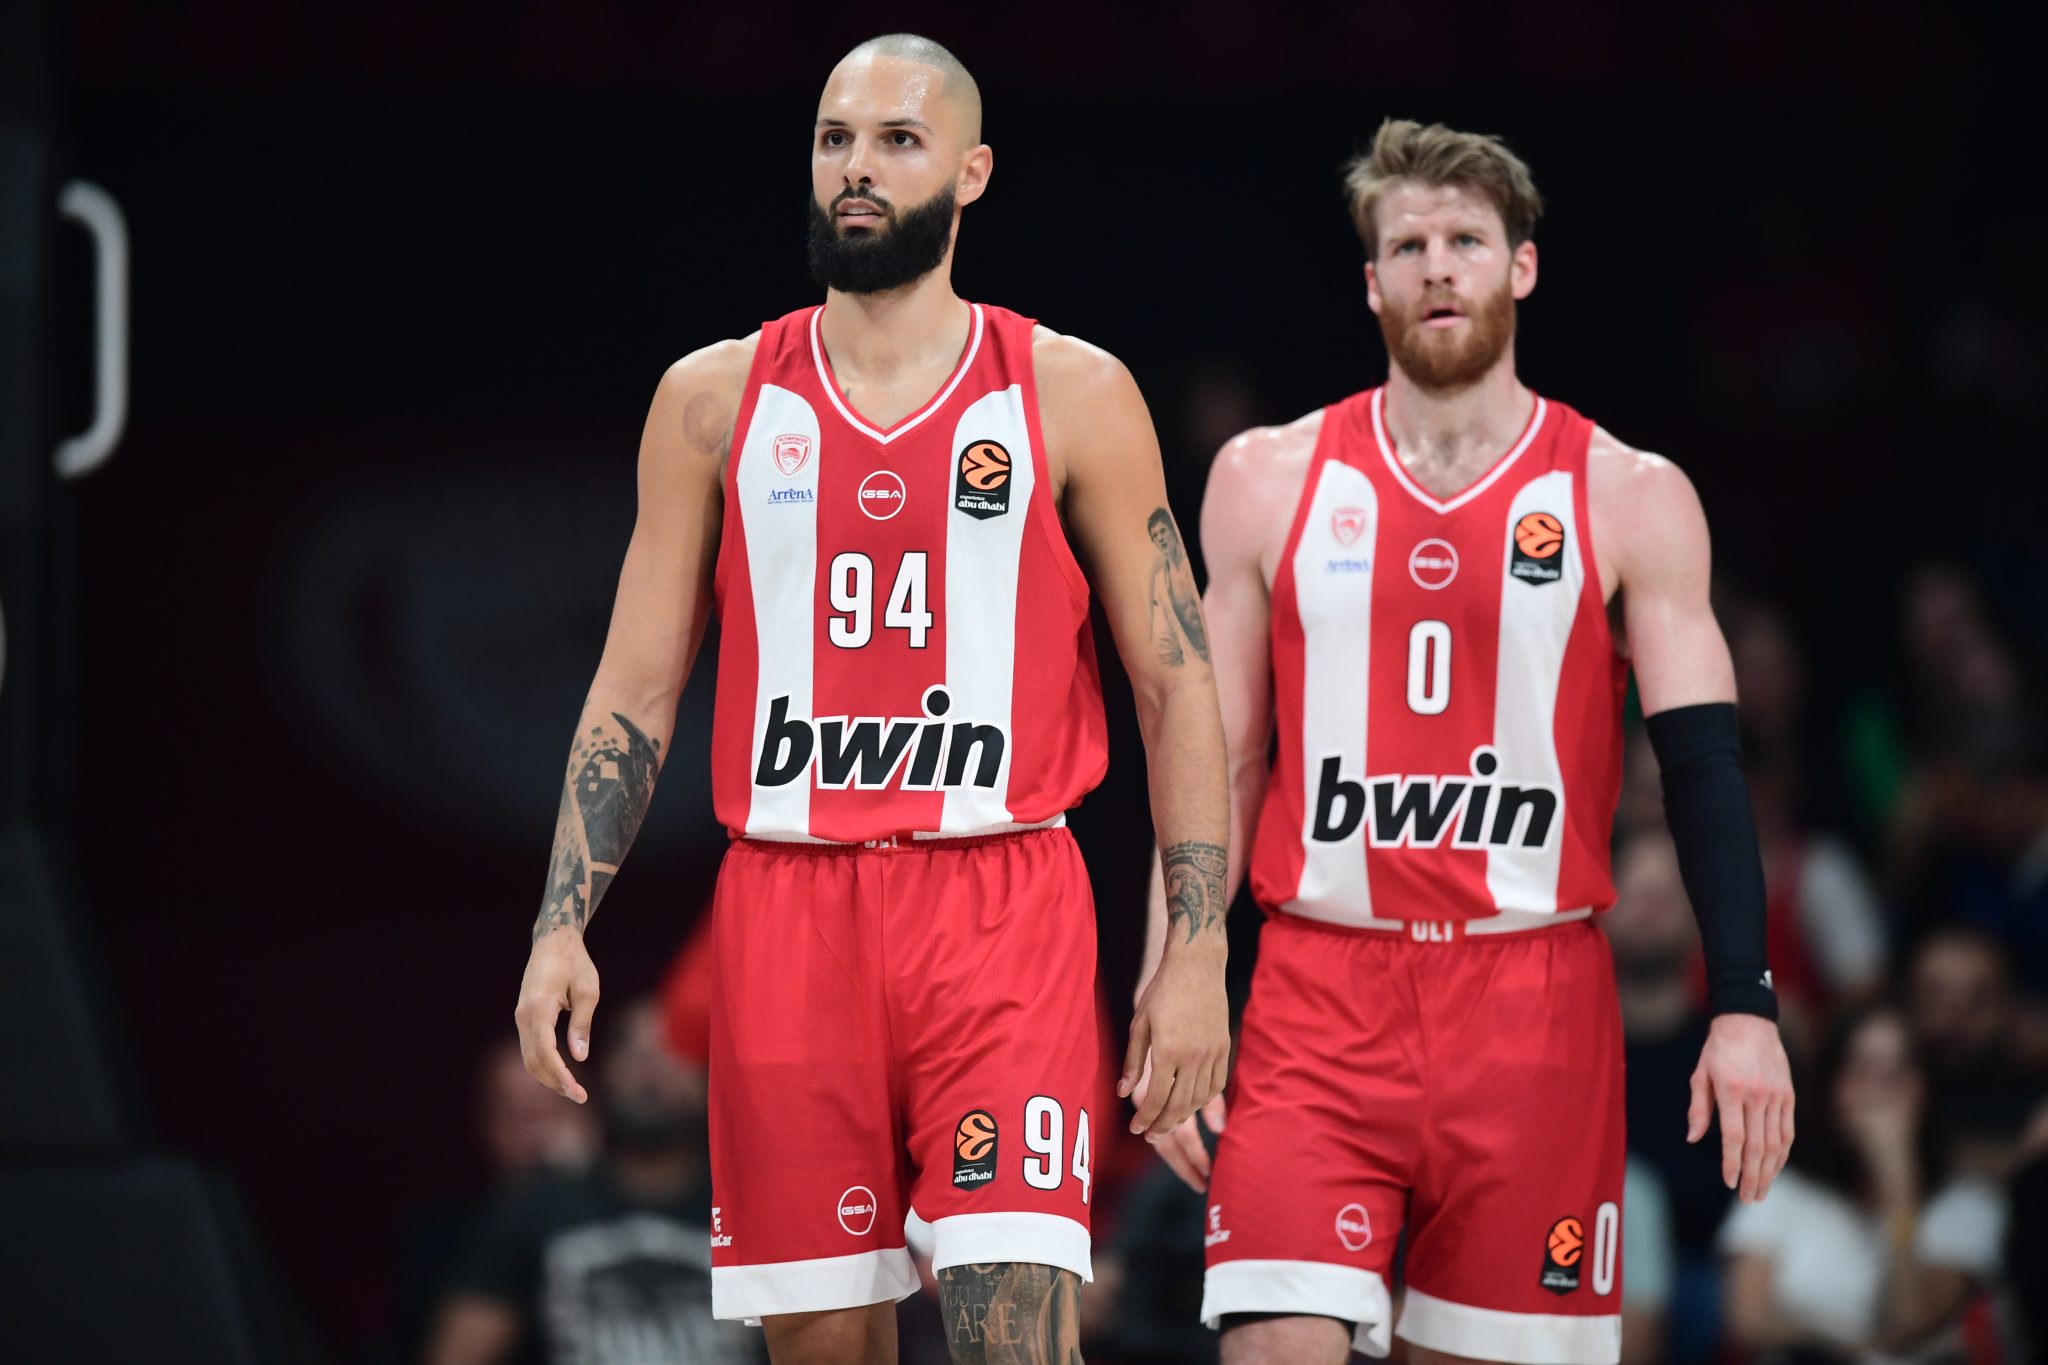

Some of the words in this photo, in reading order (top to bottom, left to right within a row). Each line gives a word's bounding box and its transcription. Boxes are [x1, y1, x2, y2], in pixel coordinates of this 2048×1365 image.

[861, 489, 902, 499] GSA
[958, 499, 977, 509] abu
[978, 501, 1006, 512] dhabi
[828, 551, 933, 649] 94
[1406, 619, 1452, 716] 0
[753, 686, 1008, 790] bwin
[1310, 750, 1559, 849] bwin
[968, 1170, 993, 1181] dhabi
[1022, 1094, 1090, 1206] 94
[841, 1204, 873, 1216] GSA
[1592, 1200, 1620, 1296] 0
